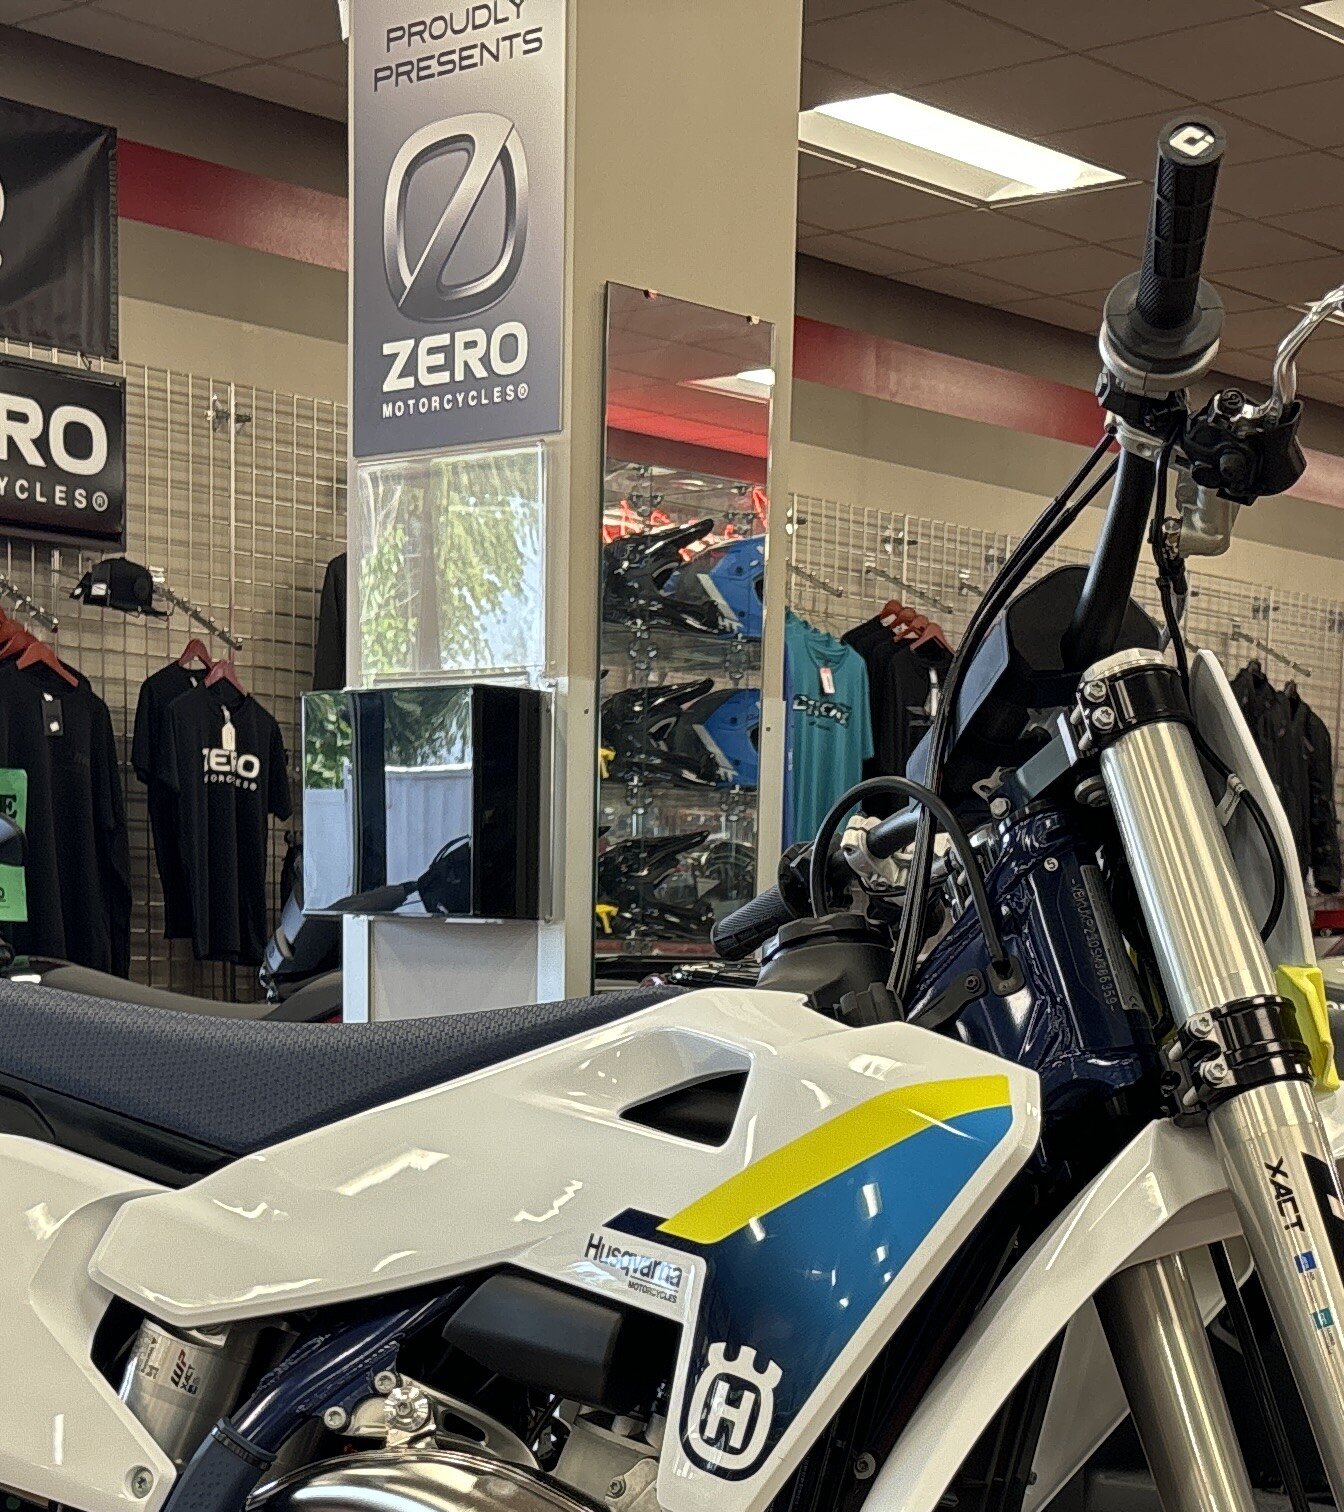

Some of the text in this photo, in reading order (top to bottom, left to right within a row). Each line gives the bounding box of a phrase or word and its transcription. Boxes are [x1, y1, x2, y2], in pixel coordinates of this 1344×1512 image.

[386, 0, 529, 53] PROUDLY
[373, 27, 544, 92] PRESENTS
[381, 321, 529, 394] ZERO
[1264, 1156, 1306, 1234] XACT
[583, 1232, 684, 1289] Husqvarna
[627, 1279, 679, 1304] MOTORCYCLES
